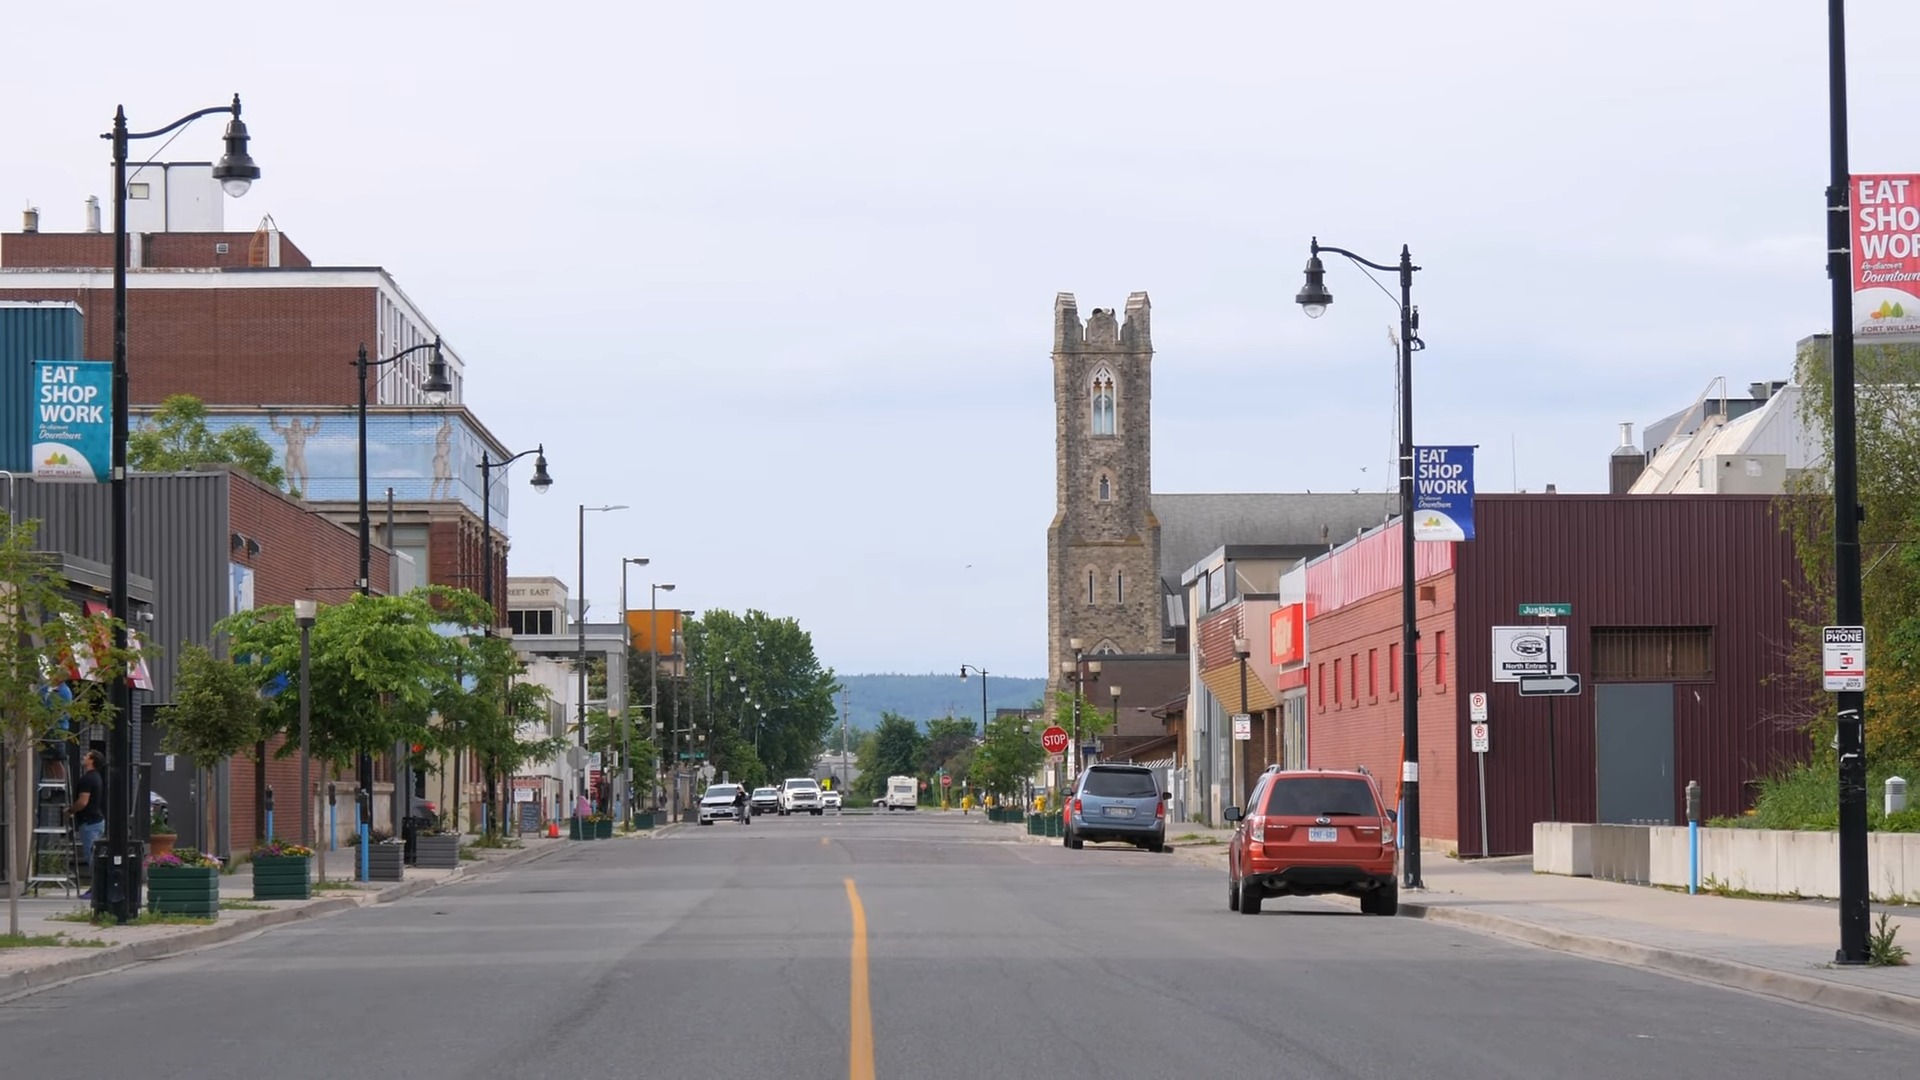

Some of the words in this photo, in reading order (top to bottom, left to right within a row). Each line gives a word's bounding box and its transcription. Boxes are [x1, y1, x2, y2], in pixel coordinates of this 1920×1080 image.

[1859, 180, 1909, 204] EAT
[1861, 270, 1920, 283] Downtown
[41, 366, 78, 384] EAT
[40, 386, 98, 404] SHOP
[40, 405, 104, 424] WORK
[38, 430, 82, 440] Downtown
[1420, 449, 1448, 464] EAT
[1418, 464, 1463, 479] SHOP
[1418, 480, 1468, 494] WORK
[1826, 634, 1862, 642] PHONE
[1044, 734, 1066, 746] STOP
